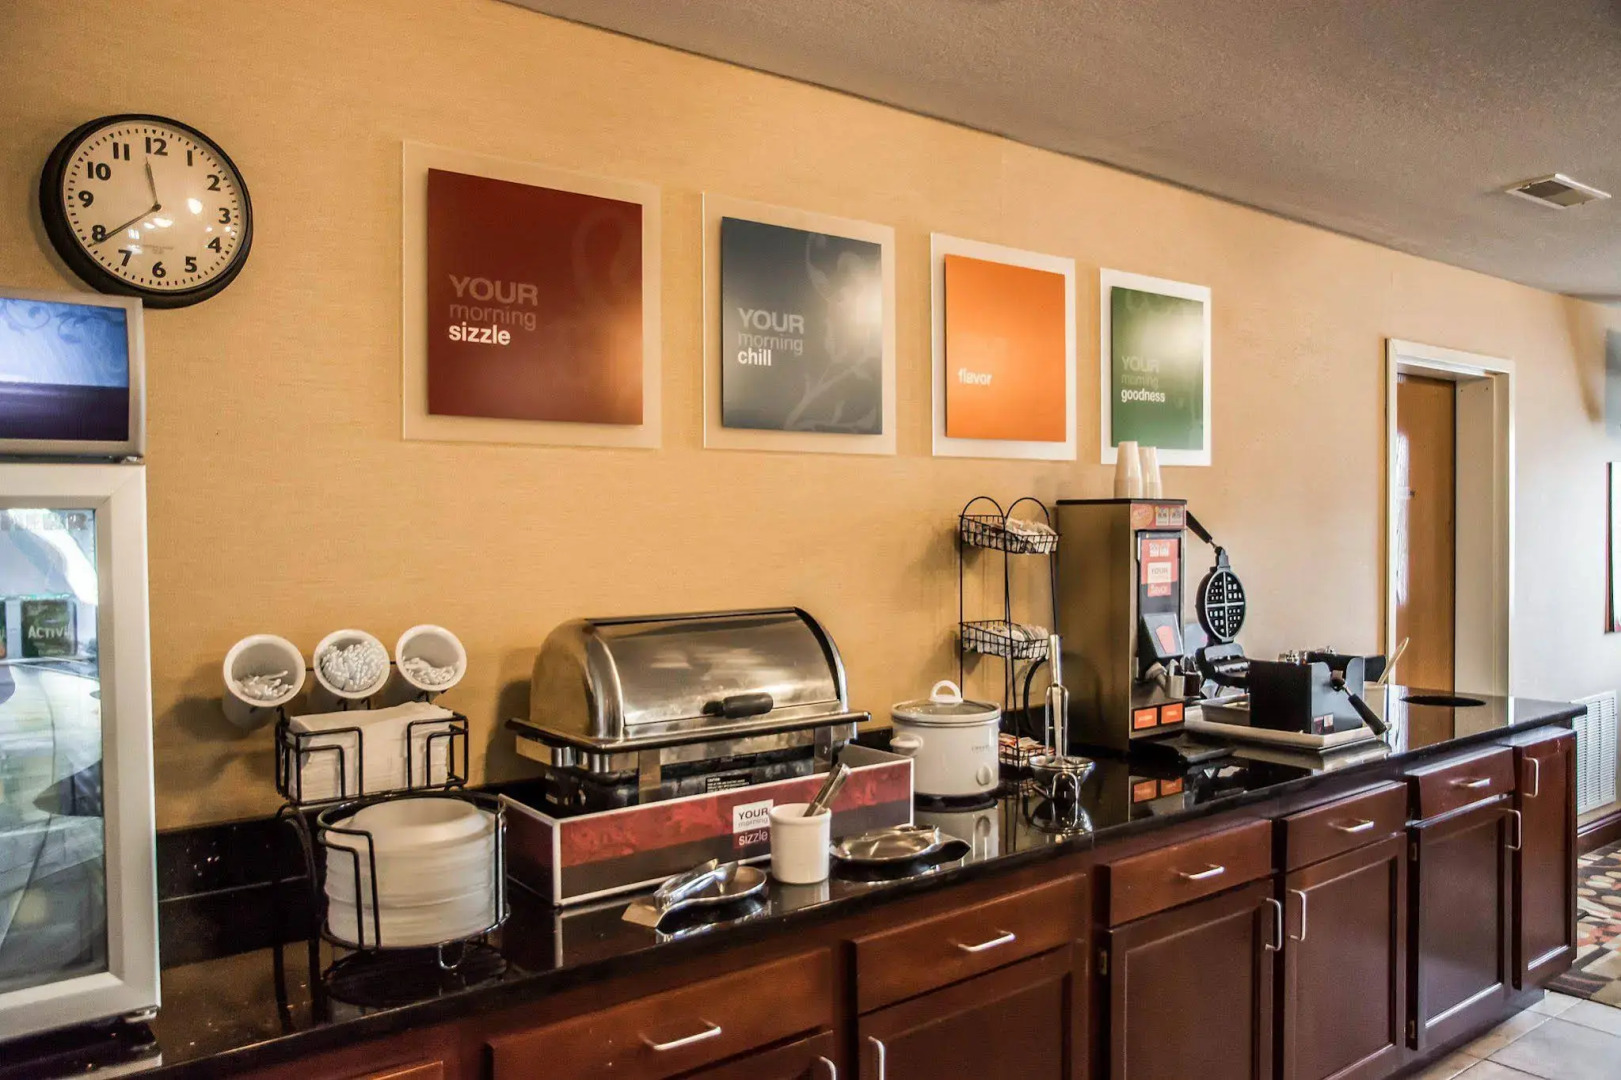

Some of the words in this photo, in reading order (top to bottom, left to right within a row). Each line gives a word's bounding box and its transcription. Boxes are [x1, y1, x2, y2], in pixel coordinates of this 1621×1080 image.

[112, 142, 130, 161] 11
[145, 136, 168, 156] 12
[186, 150, 193, 167] 1
[87, 161, 111, 181] 10
[206, 174, 221, 191] 2
[78, 190, 94, 208] 9
[218, 207, 231, 224] 3
[92, 225, 106, 242] 8
[208, 237, 222, 253] 4
[118, 249, 132, 266] 7
[184, 256, 198, 273] 5
[152, 261, 166, 278] 6
[448, 273, 539, 306] YOUR
[449, 304, 537, 331] morning
[737, 307, 804, 334] YOUR
[448, 321, 511, 345] sizzle
[738, 331, 803, 356] morning
[737, 347, 772, 366] chill
[1121, 356, 1159, 373] YOUR
[958, 367, 992, 386] flavor
[1121, 388, 1165, 403] goodness
[738, 807, 769, 820] YOUR
[738, 817, 769, 829] morning
[738, 830, 768, 846] sizzle
